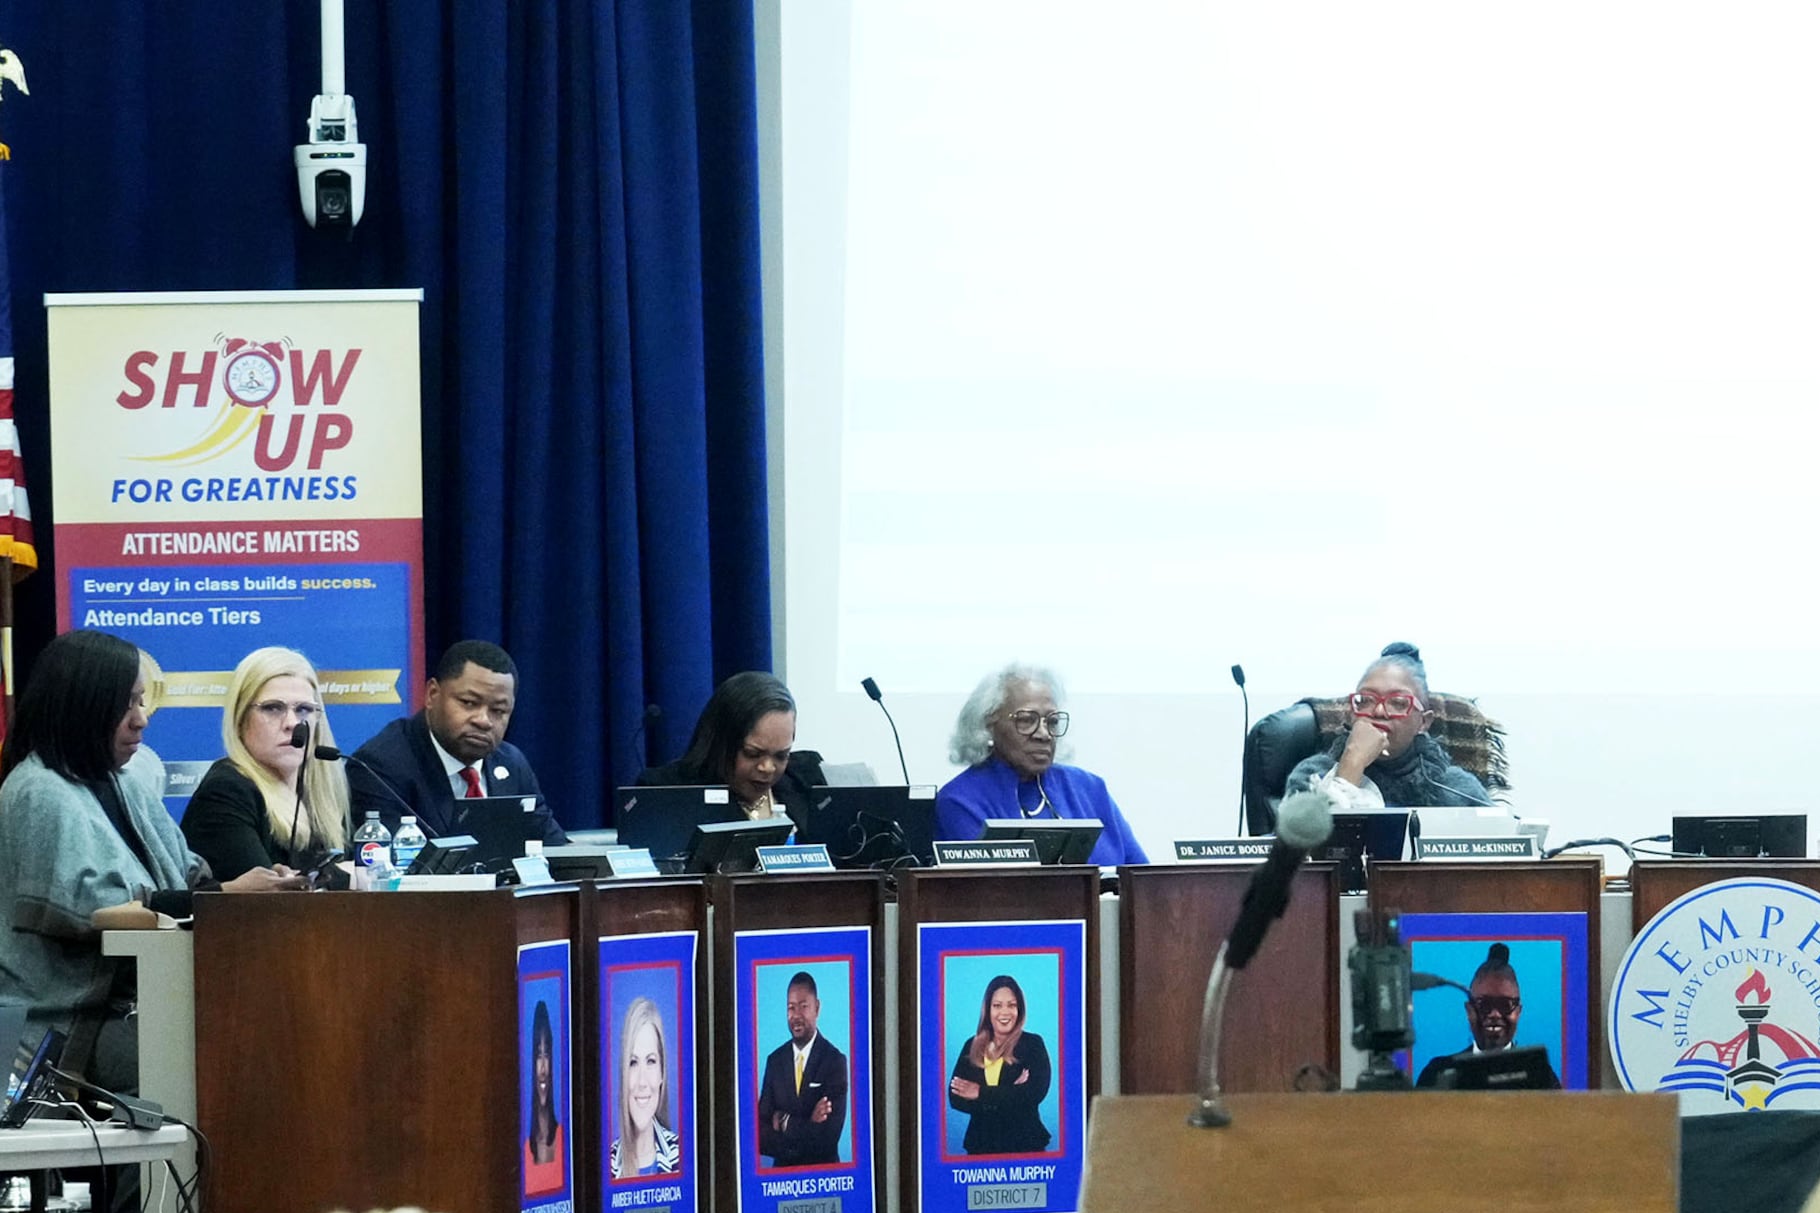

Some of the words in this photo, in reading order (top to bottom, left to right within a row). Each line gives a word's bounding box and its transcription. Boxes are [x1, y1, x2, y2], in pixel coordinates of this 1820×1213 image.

[253, 413, 353, 472] UP
[111, 479, 173, 503] FOR
[181, 476, 357, 502] GREATNESS
[121, 531, 258, 555] ATTENDANCE
[263, 530, 360, 553] MATTERS
[83, 579, 134, 596] Every
[138, 578, 170, 595] day
[174, 577, 190, 591] in
[194, 576, 240, 591] class
[244, 576, 297, 591] builds
[301, 577, 377, 590] success.
[83, 608, 203, 627] Attendance
[208, 606, 261, 625] Tiers
[170, 773, 194, 785] Silver
[943, 849, 989, 860] TOWANNA
[991, 849, 1030, 859] MURPHY
[1181, 847, 1197, 855] DR.
[1200, 846, 1236, 855] JANICE
[1238, 844, 1273, 855] BOOKE
[1423, 843, 1469, 853] NATALIE
[1472, 843, 1526, 853] McKINNEY
[1673, 974, 1705, 1048] SHELBY
[1703, 948, 1789, 977] COUNTY
[952, 1167, 1007, 1184] TOWANNA
[1009, 1165, 1056, 1181] MURPHY
[761, 1178, 816, 1198] TAMARQUES
[818, 1176, 854, 1193] PORTER
[973, 1188, 1028, 1206] DISTRICT
[1033, 1188, 1040, 1203] 7
